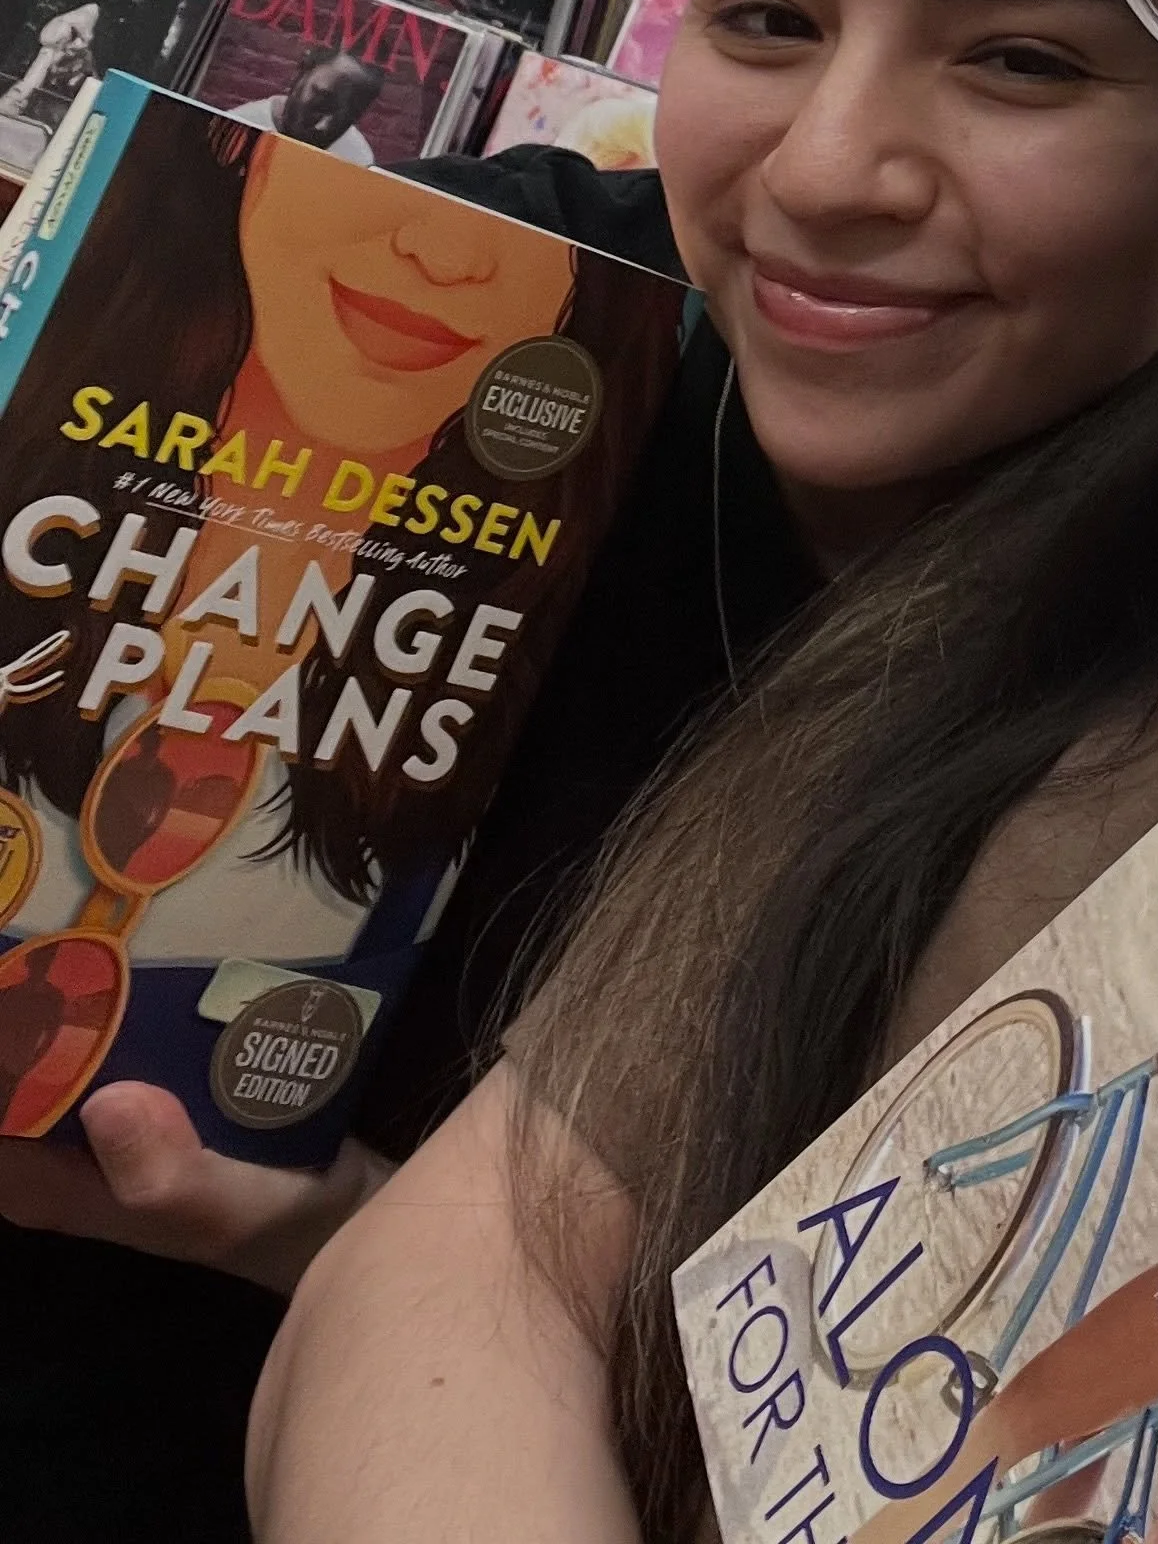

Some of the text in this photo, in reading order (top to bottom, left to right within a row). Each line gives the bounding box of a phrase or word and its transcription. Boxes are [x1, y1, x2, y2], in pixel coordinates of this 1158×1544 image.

[59, 386, 562, 567] SARAH DESSEN
[481, 384, 587, 435] EXCLUSIVE
[112, 471, 152, 494] #1
[147, 482, 201, 507] New
[198, 496, 247, 523] York
[251, 507, 306, 537] Times
[404, 550, 469, 579] Author
[2, 494, 524, 693] CHANGE
[78, 621, 475, 783] PLANS
[232, 1072, 312, 1107] EDITION
[234, 1031, 339, 1080] SIGNED
[715, 1253, 806, 1466] FOR
